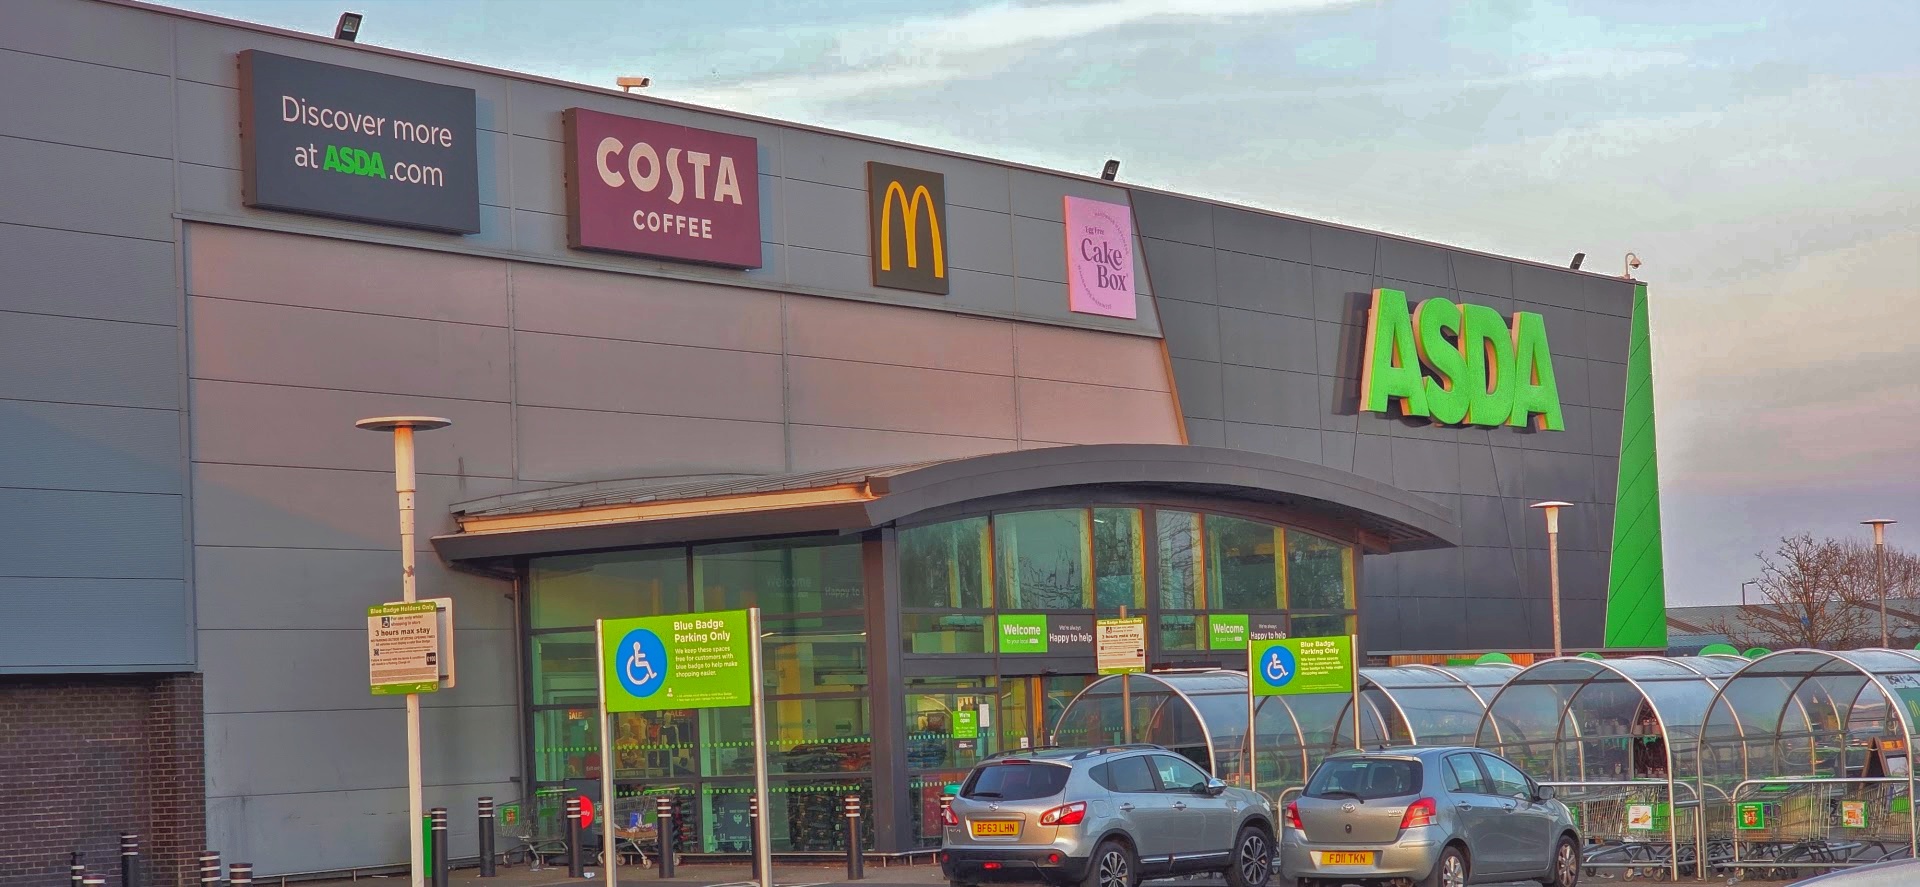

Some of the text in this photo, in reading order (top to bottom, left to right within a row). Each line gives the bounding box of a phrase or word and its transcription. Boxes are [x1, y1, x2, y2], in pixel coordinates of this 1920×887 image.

[282, 95, 453, 148] Discover more
[294, 143, 319, 169] at
[596, 136, 743, 206] COSTA
[632, 209, 713, 240] COFFEE
[1081, 237, 1123, 271] Cake
[1097, 264, 1128, 292] Box
[1361, 287, 1566, 432] ASDA
[674, 619, 724, 630] Blue Badge
[1003, 624, 1041, 635] Welcome
[1069, 624, 1082, 632] always
[1213, 623, 1245, 634] Welcome
[675, 631, 731, 643] Parking Only
[1049, 632, 1070, 644] Happy
[1070, 632, 1078, 642] to
[1078, 632, 1093, 644] help
[1250, 631, 1287, 641] Happy to help
[1315, 640, 1335, 648] Badge
[1300, 647, 1340, 656] Parking Only
[976, 823, 1015, 833] BF63 LHN
[1328, 853, 1366, 864] FD11 TKN
